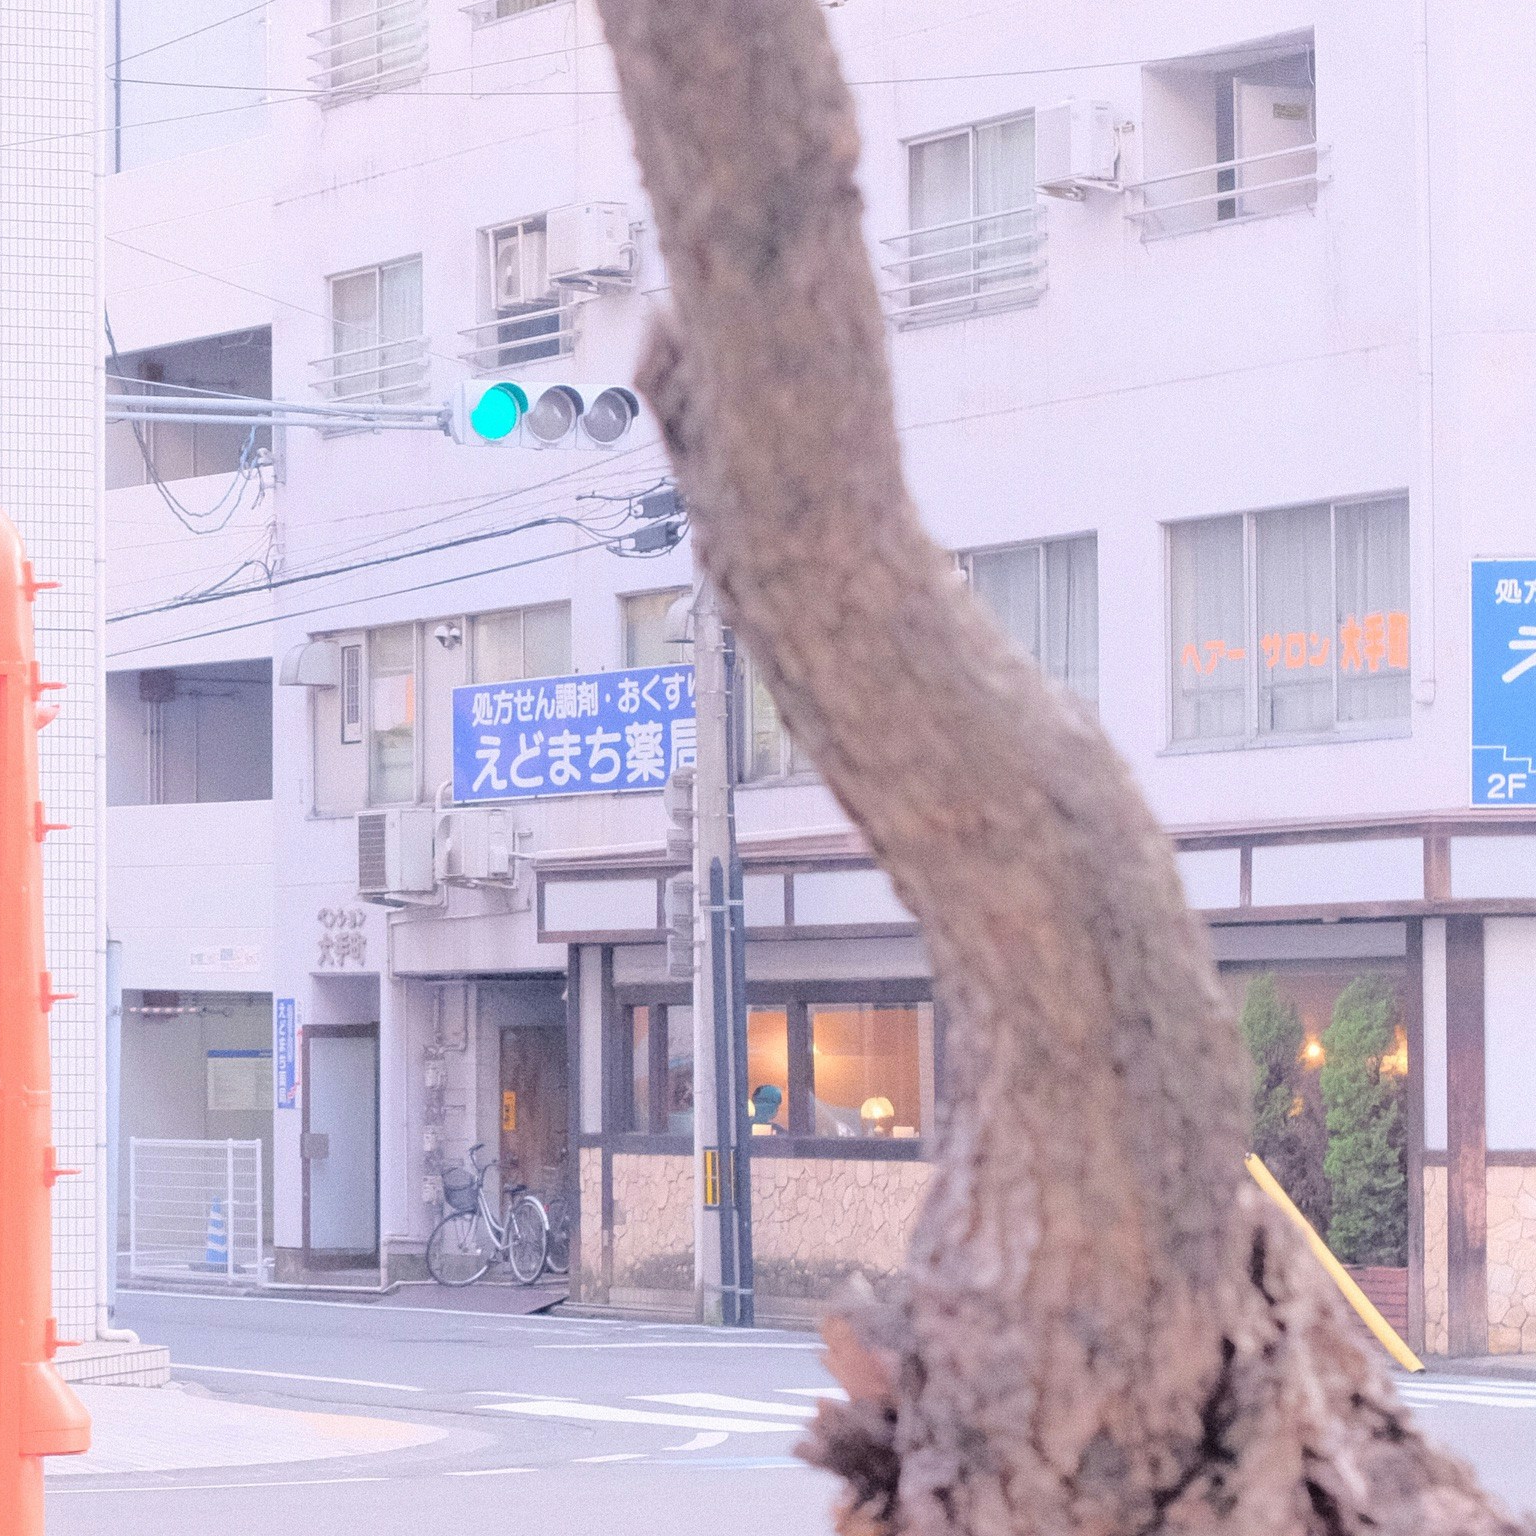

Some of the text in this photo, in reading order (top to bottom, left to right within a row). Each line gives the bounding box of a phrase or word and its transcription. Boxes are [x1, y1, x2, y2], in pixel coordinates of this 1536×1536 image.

[1180, 640, 1245, 675] ヘアー
[1260, 631, 1331, 670] サロン
[1487, 772, 1528, 800] 2F
